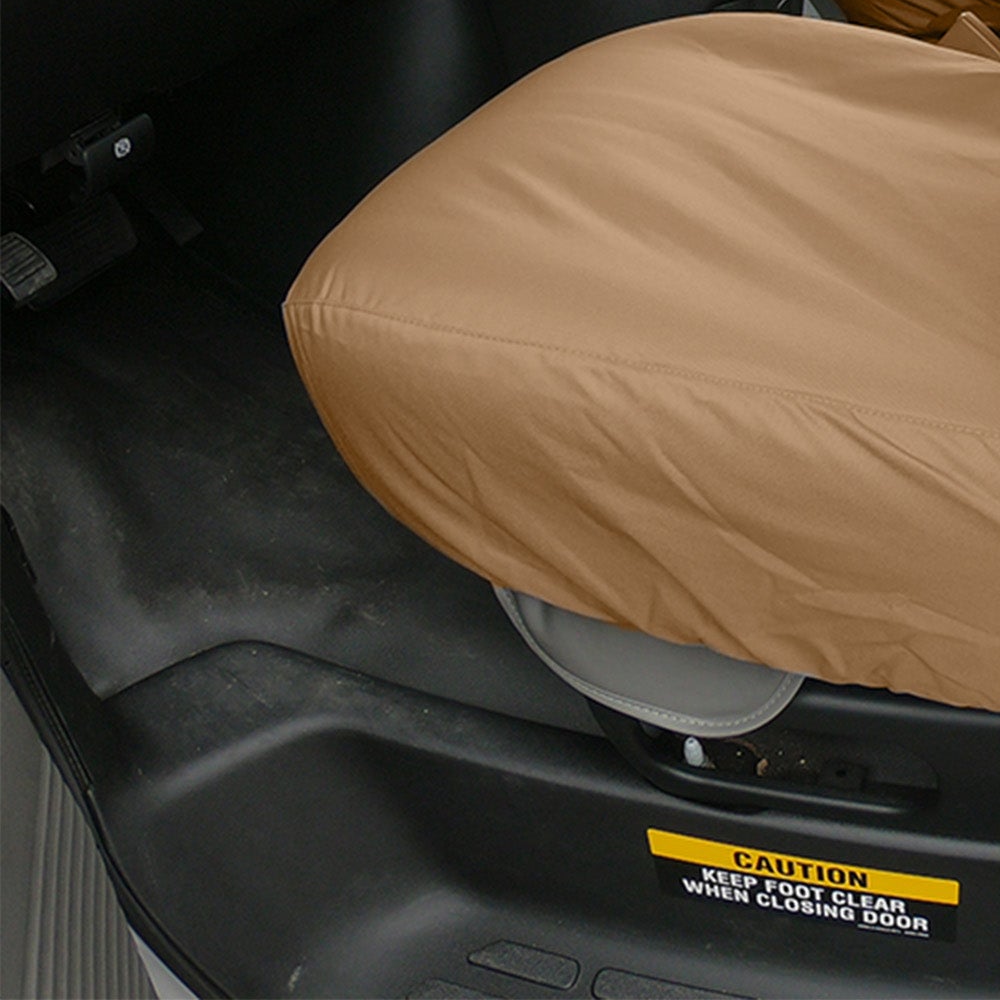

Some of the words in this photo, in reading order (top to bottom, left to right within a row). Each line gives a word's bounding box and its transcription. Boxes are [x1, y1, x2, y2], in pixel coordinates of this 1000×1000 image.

[702, 868, 757, 889] KEEP
[764, 880, 824, 900] FOOT
[832, 891, 906, 913] CLEAR
[733, 851, 868, 888] CAUTION
[682, 878, 749, 904] WHEN
[756, 893, 855, 921] CLOSING
[863, 909, 929, 931] DOOR
